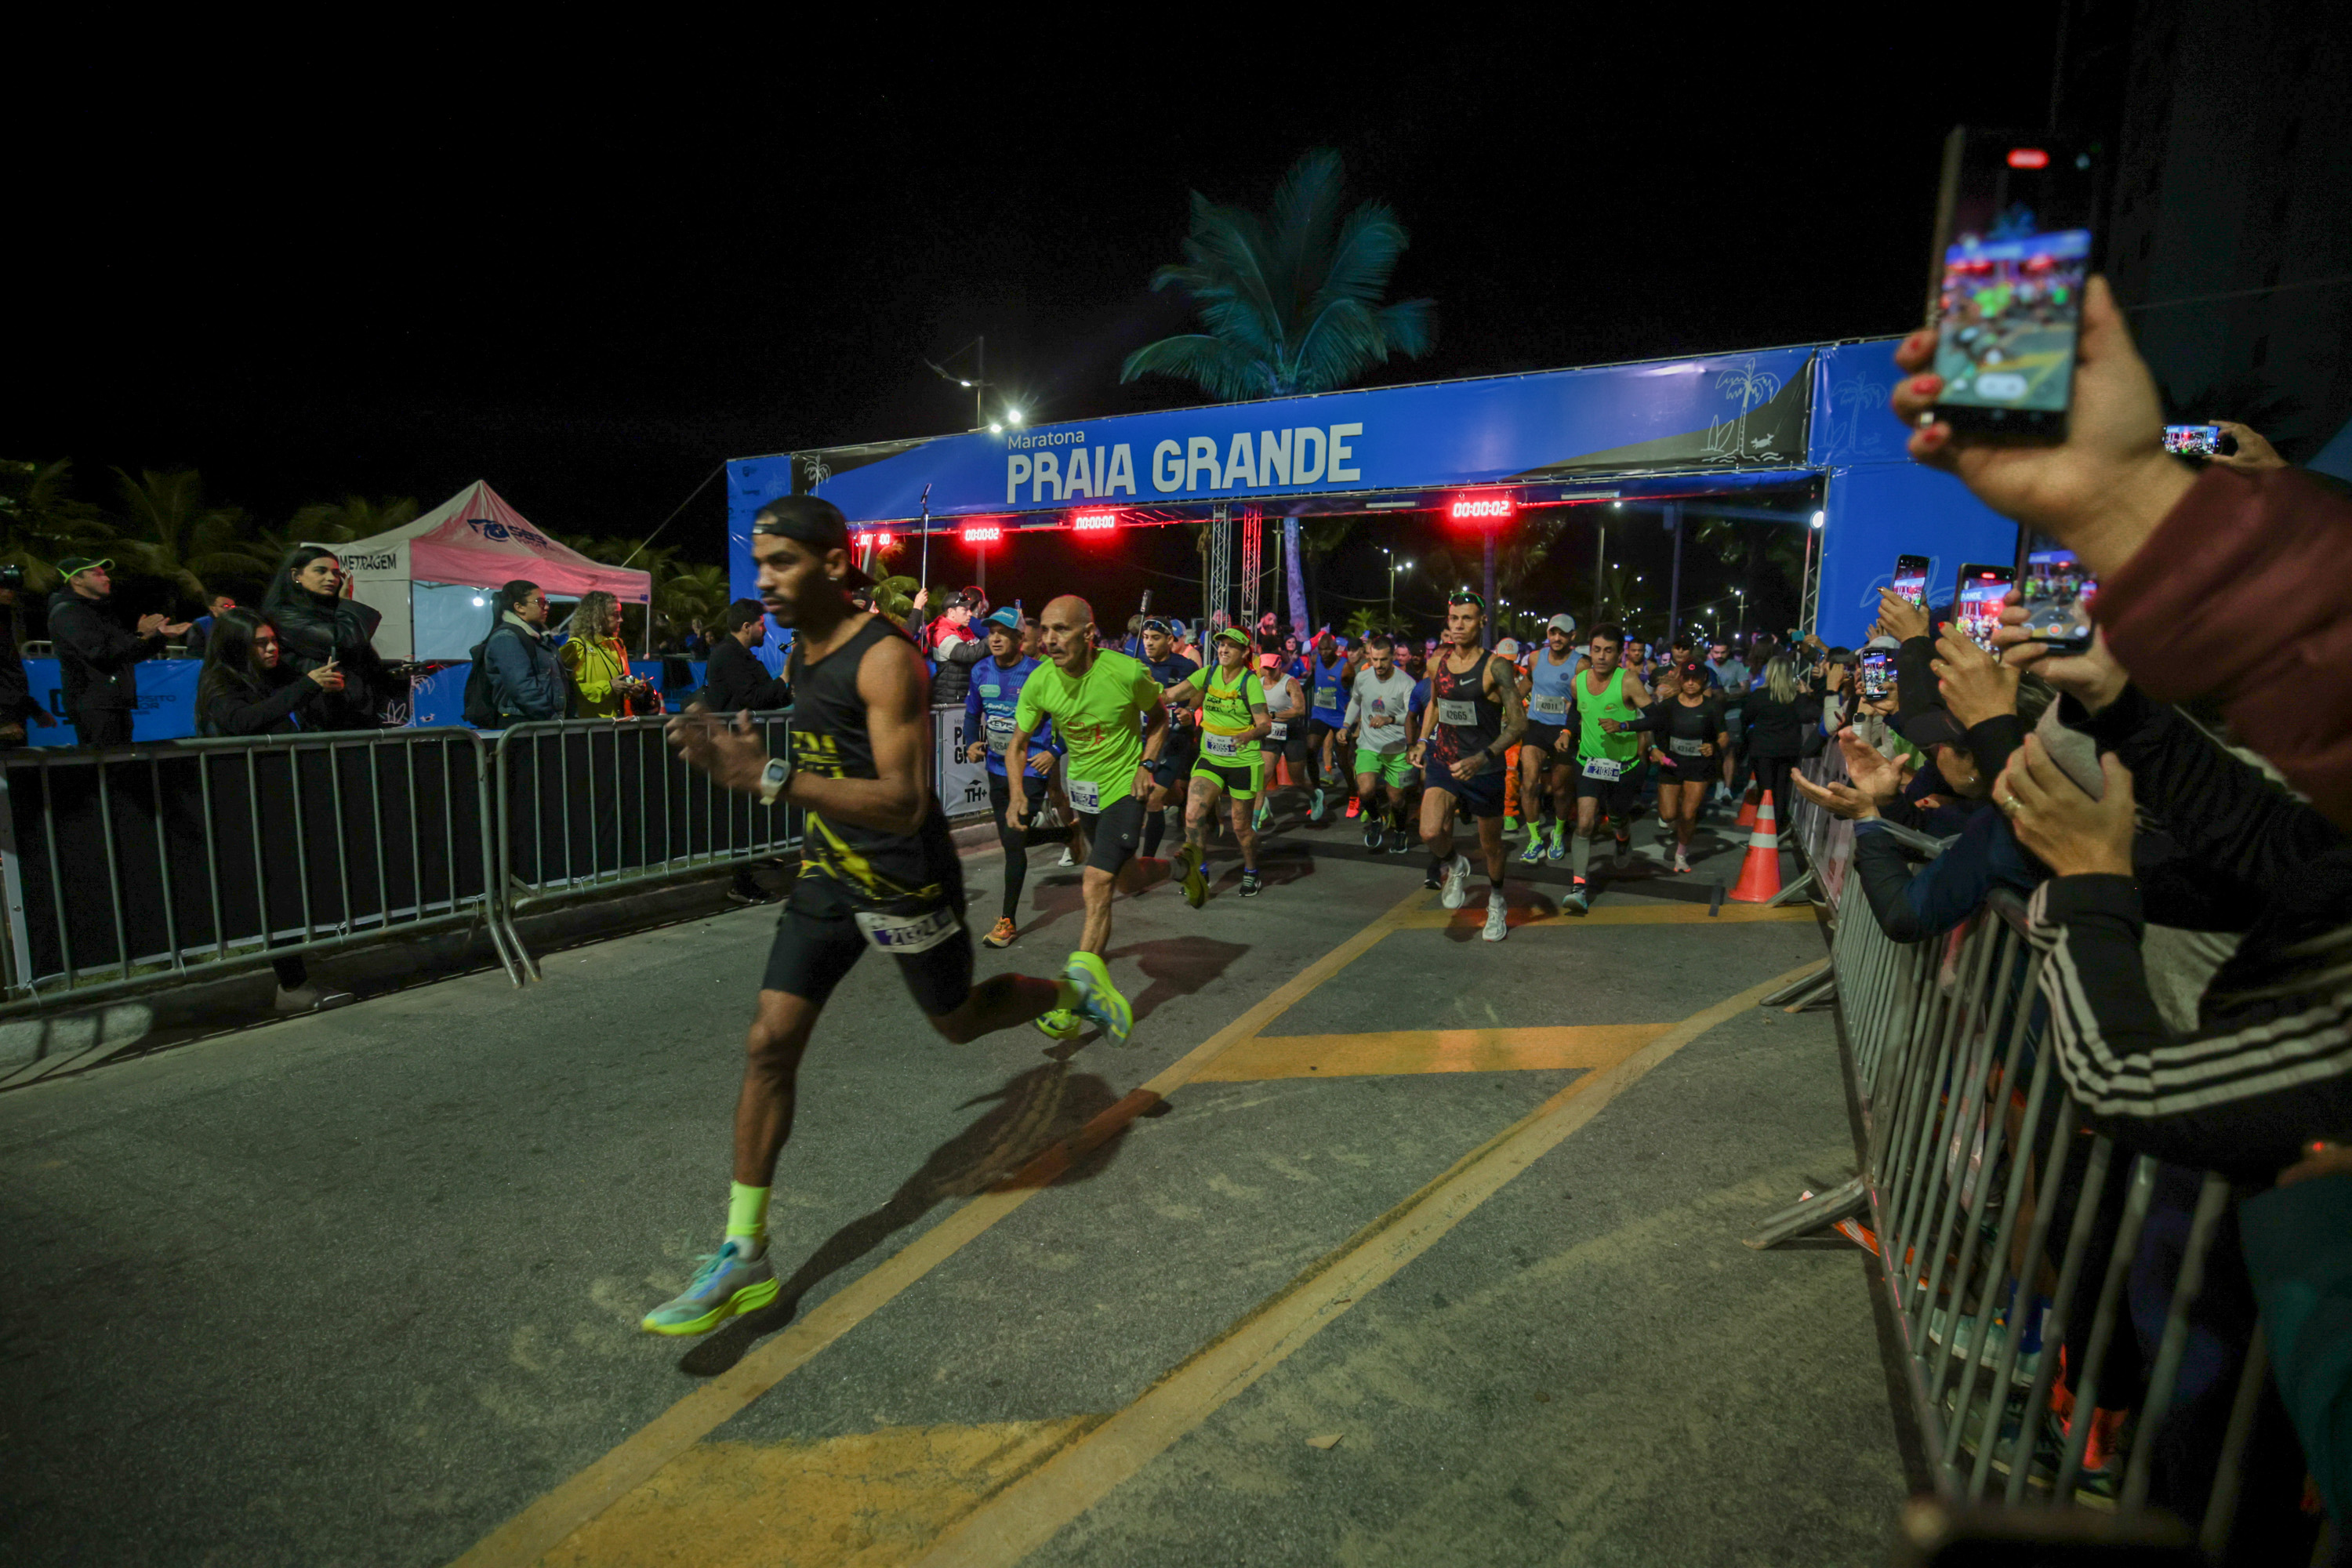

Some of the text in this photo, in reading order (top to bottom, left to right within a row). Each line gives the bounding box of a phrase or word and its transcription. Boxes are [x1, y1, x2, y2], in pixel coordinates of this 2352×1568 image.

[1007, 430, 1086, 450] Maratona
[1006, 422, 1363, 505] PRAIA GRANDE
[1453, 500, 1511, 517] 00:00:02
[965, 527, 1000, 541] 00:00:02
[339, 554, 397, 571] METRAGEM
[1446, 710, 1468, 720] 42665
[1593, 766, 1613, 776] 21036
